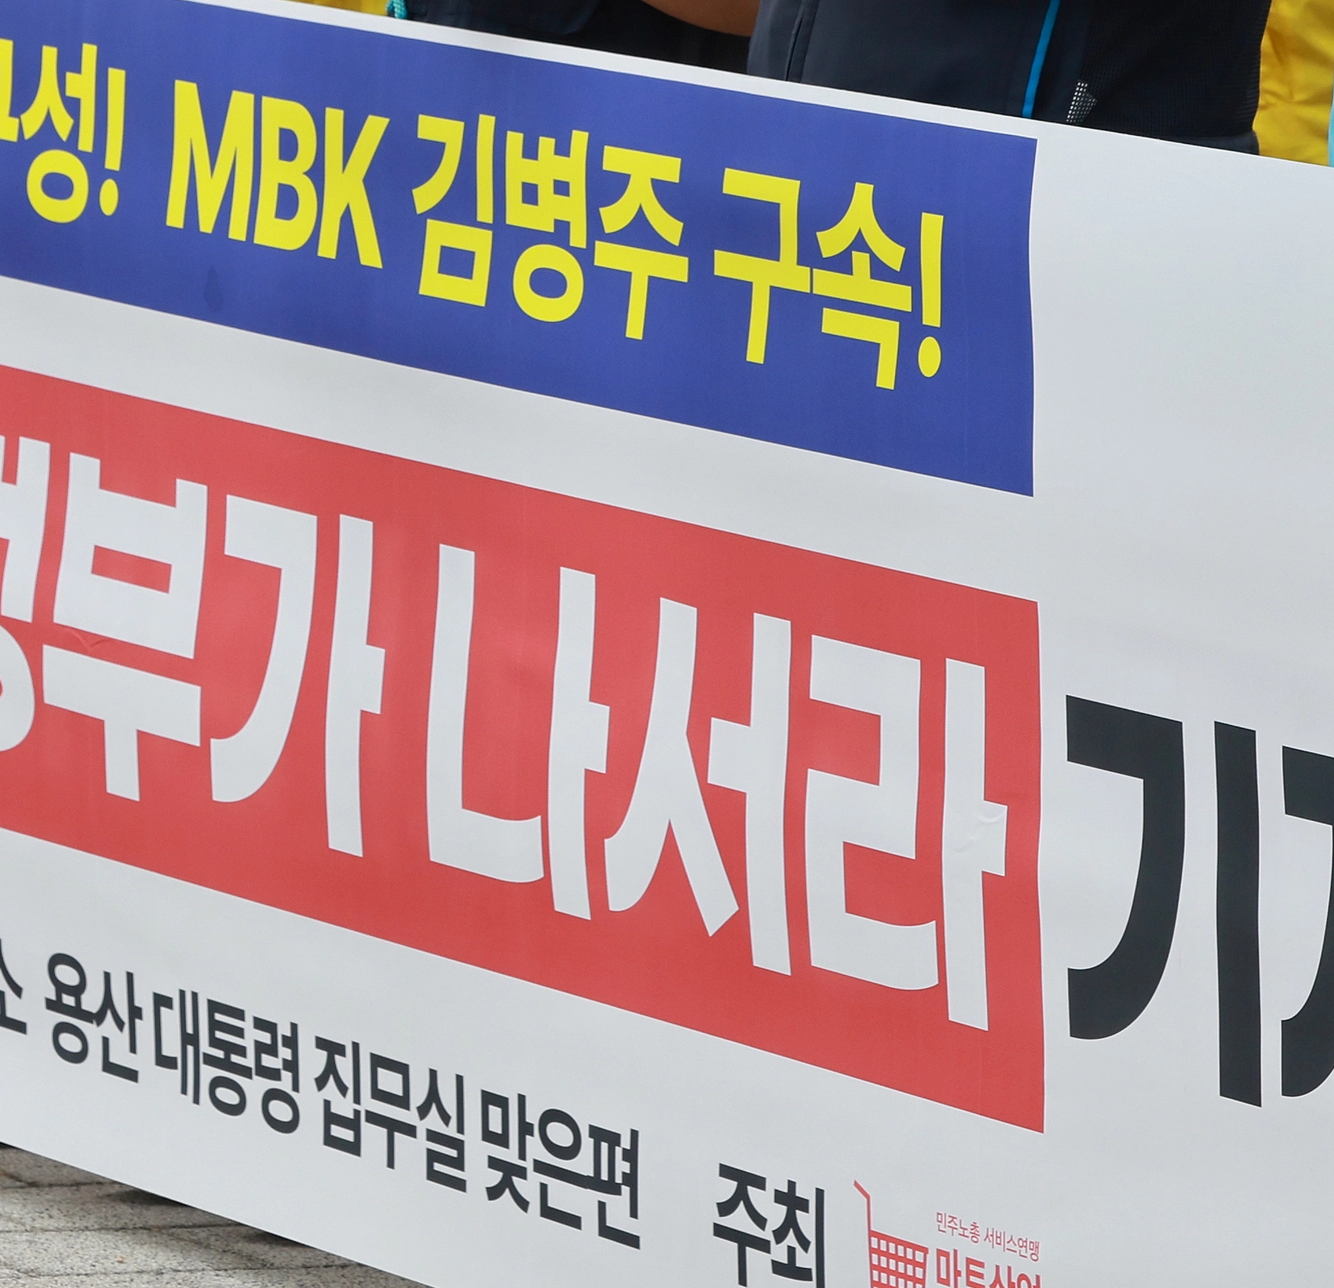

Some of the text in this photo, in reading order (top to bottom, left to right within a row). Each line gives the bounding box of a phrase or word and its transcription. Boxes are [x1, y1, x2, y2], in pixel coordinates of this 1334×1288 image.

[166, 79, 390, 271] MBK
[412, 114, 689, 341] 김병주
[714, 168, 945, 392] 구속!
[426, 543, 1008, 1032] 나서라
[44, 952, 143, 1083] 용산
[152, 988, 301, 1135] 대통령
[314, 1035, 468, 1193] 집무실
[479, 1088, 641, 1251] 맞은편
[713, 1162, 825, 1288] 주최
[936, 1211, 1040, 1262] 민주노총 서비스연맹
